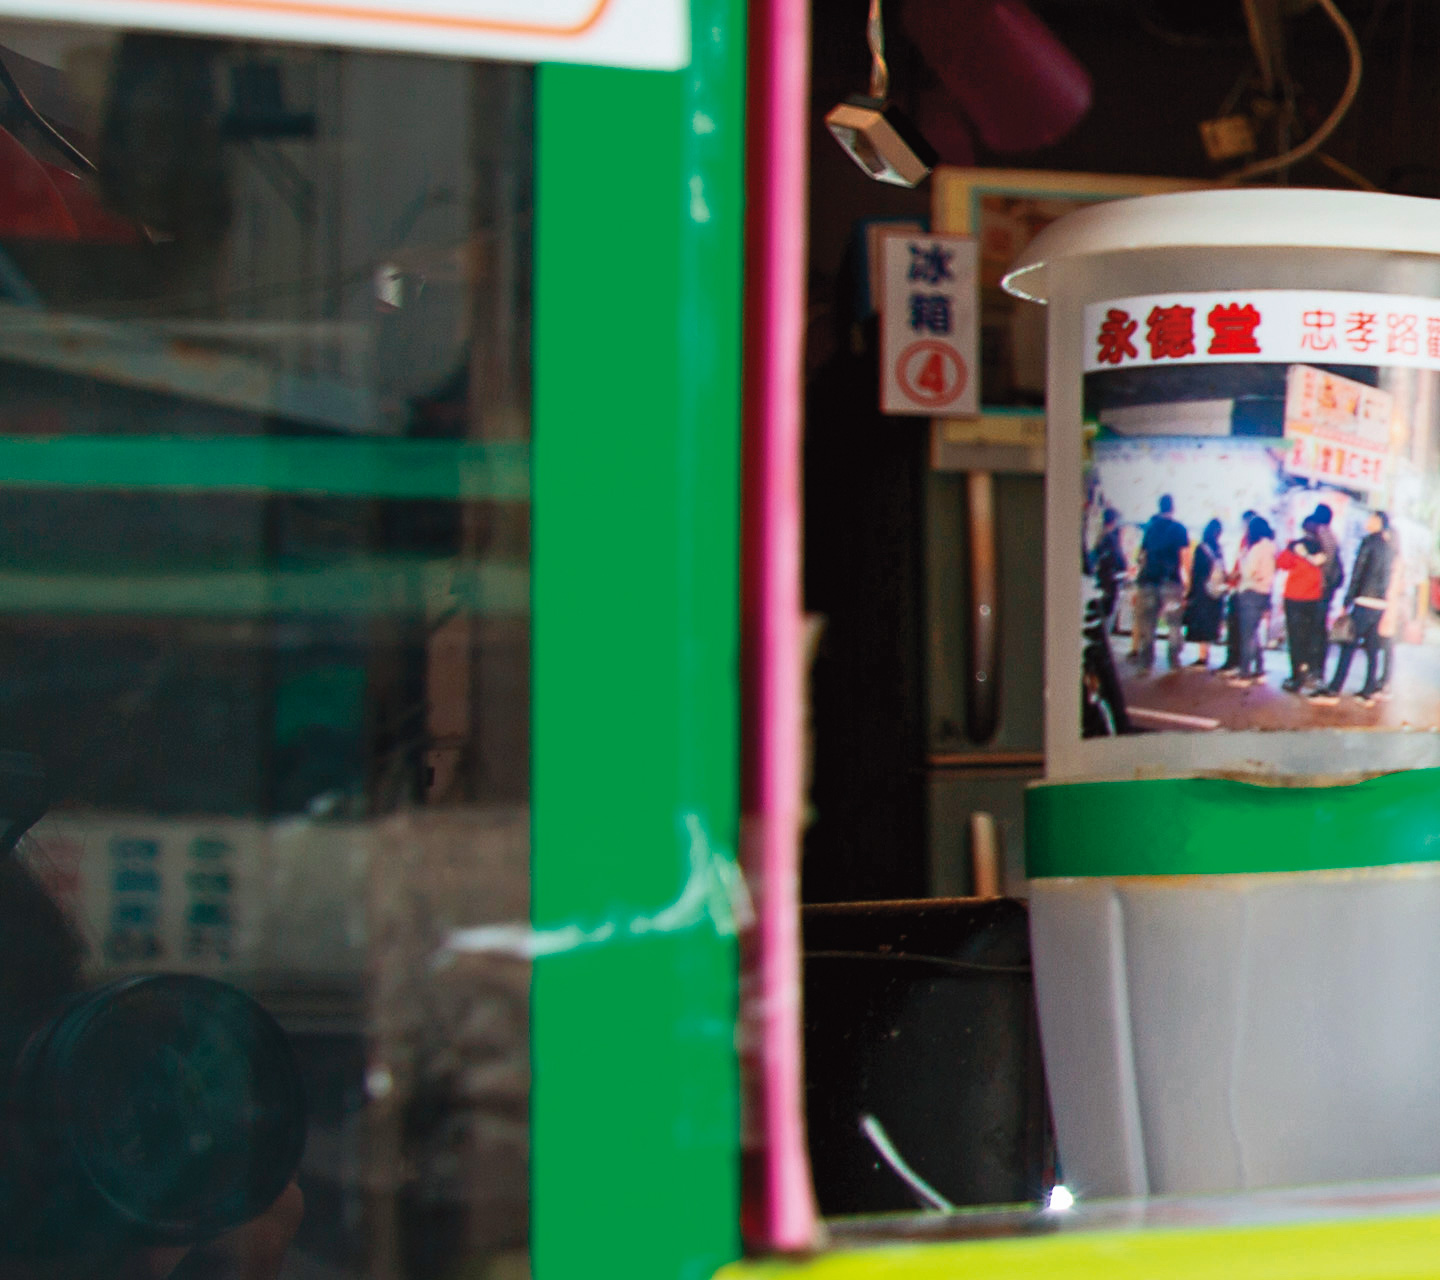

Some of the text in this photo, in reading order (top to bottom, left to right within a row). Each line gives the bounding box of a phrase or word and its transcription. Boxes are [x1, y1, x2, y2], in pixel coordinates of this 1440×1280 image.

[906, 244, 955, 337] 冰箱
[1096, 301, 1263, 366] 永德堂
